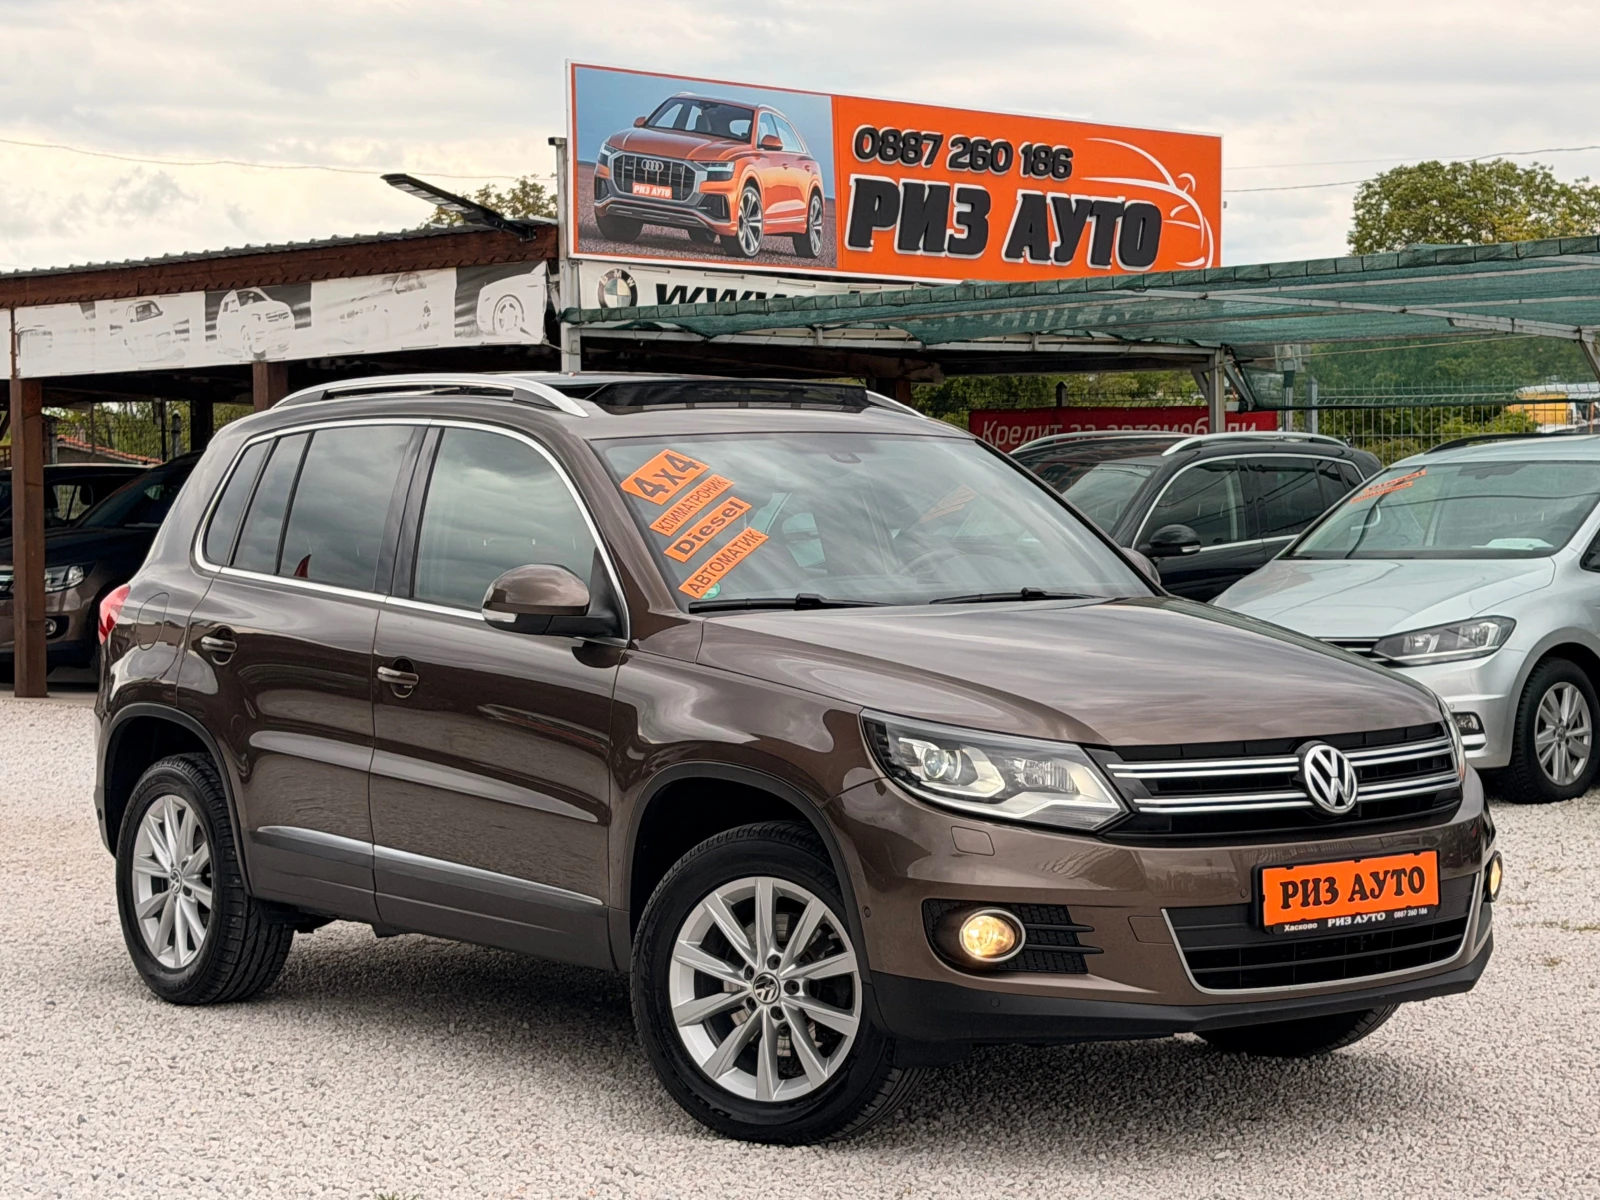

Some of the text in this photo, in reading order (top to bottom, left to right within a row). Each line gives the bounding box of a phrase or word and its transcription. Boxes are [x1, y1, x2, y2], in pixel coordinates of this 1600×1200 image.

[852, 125, 1074, 181] 0887 260 186
[845, 174, 1162, 271] РИЗ АУТО
[655, 478, 728, 532] КЛИМАТРОНИК
[673, 500, 745, 555] Diesel
[688, 530, 763, 594] АВТОМАТИК
[1280, 866, 1425, 909] РИЗ АУТО
[1284, 922, 1318, 932] Хасково
[1327, 917, 1352, 927] РИЗ
[1354, 912, 1386, 924] АУТО
